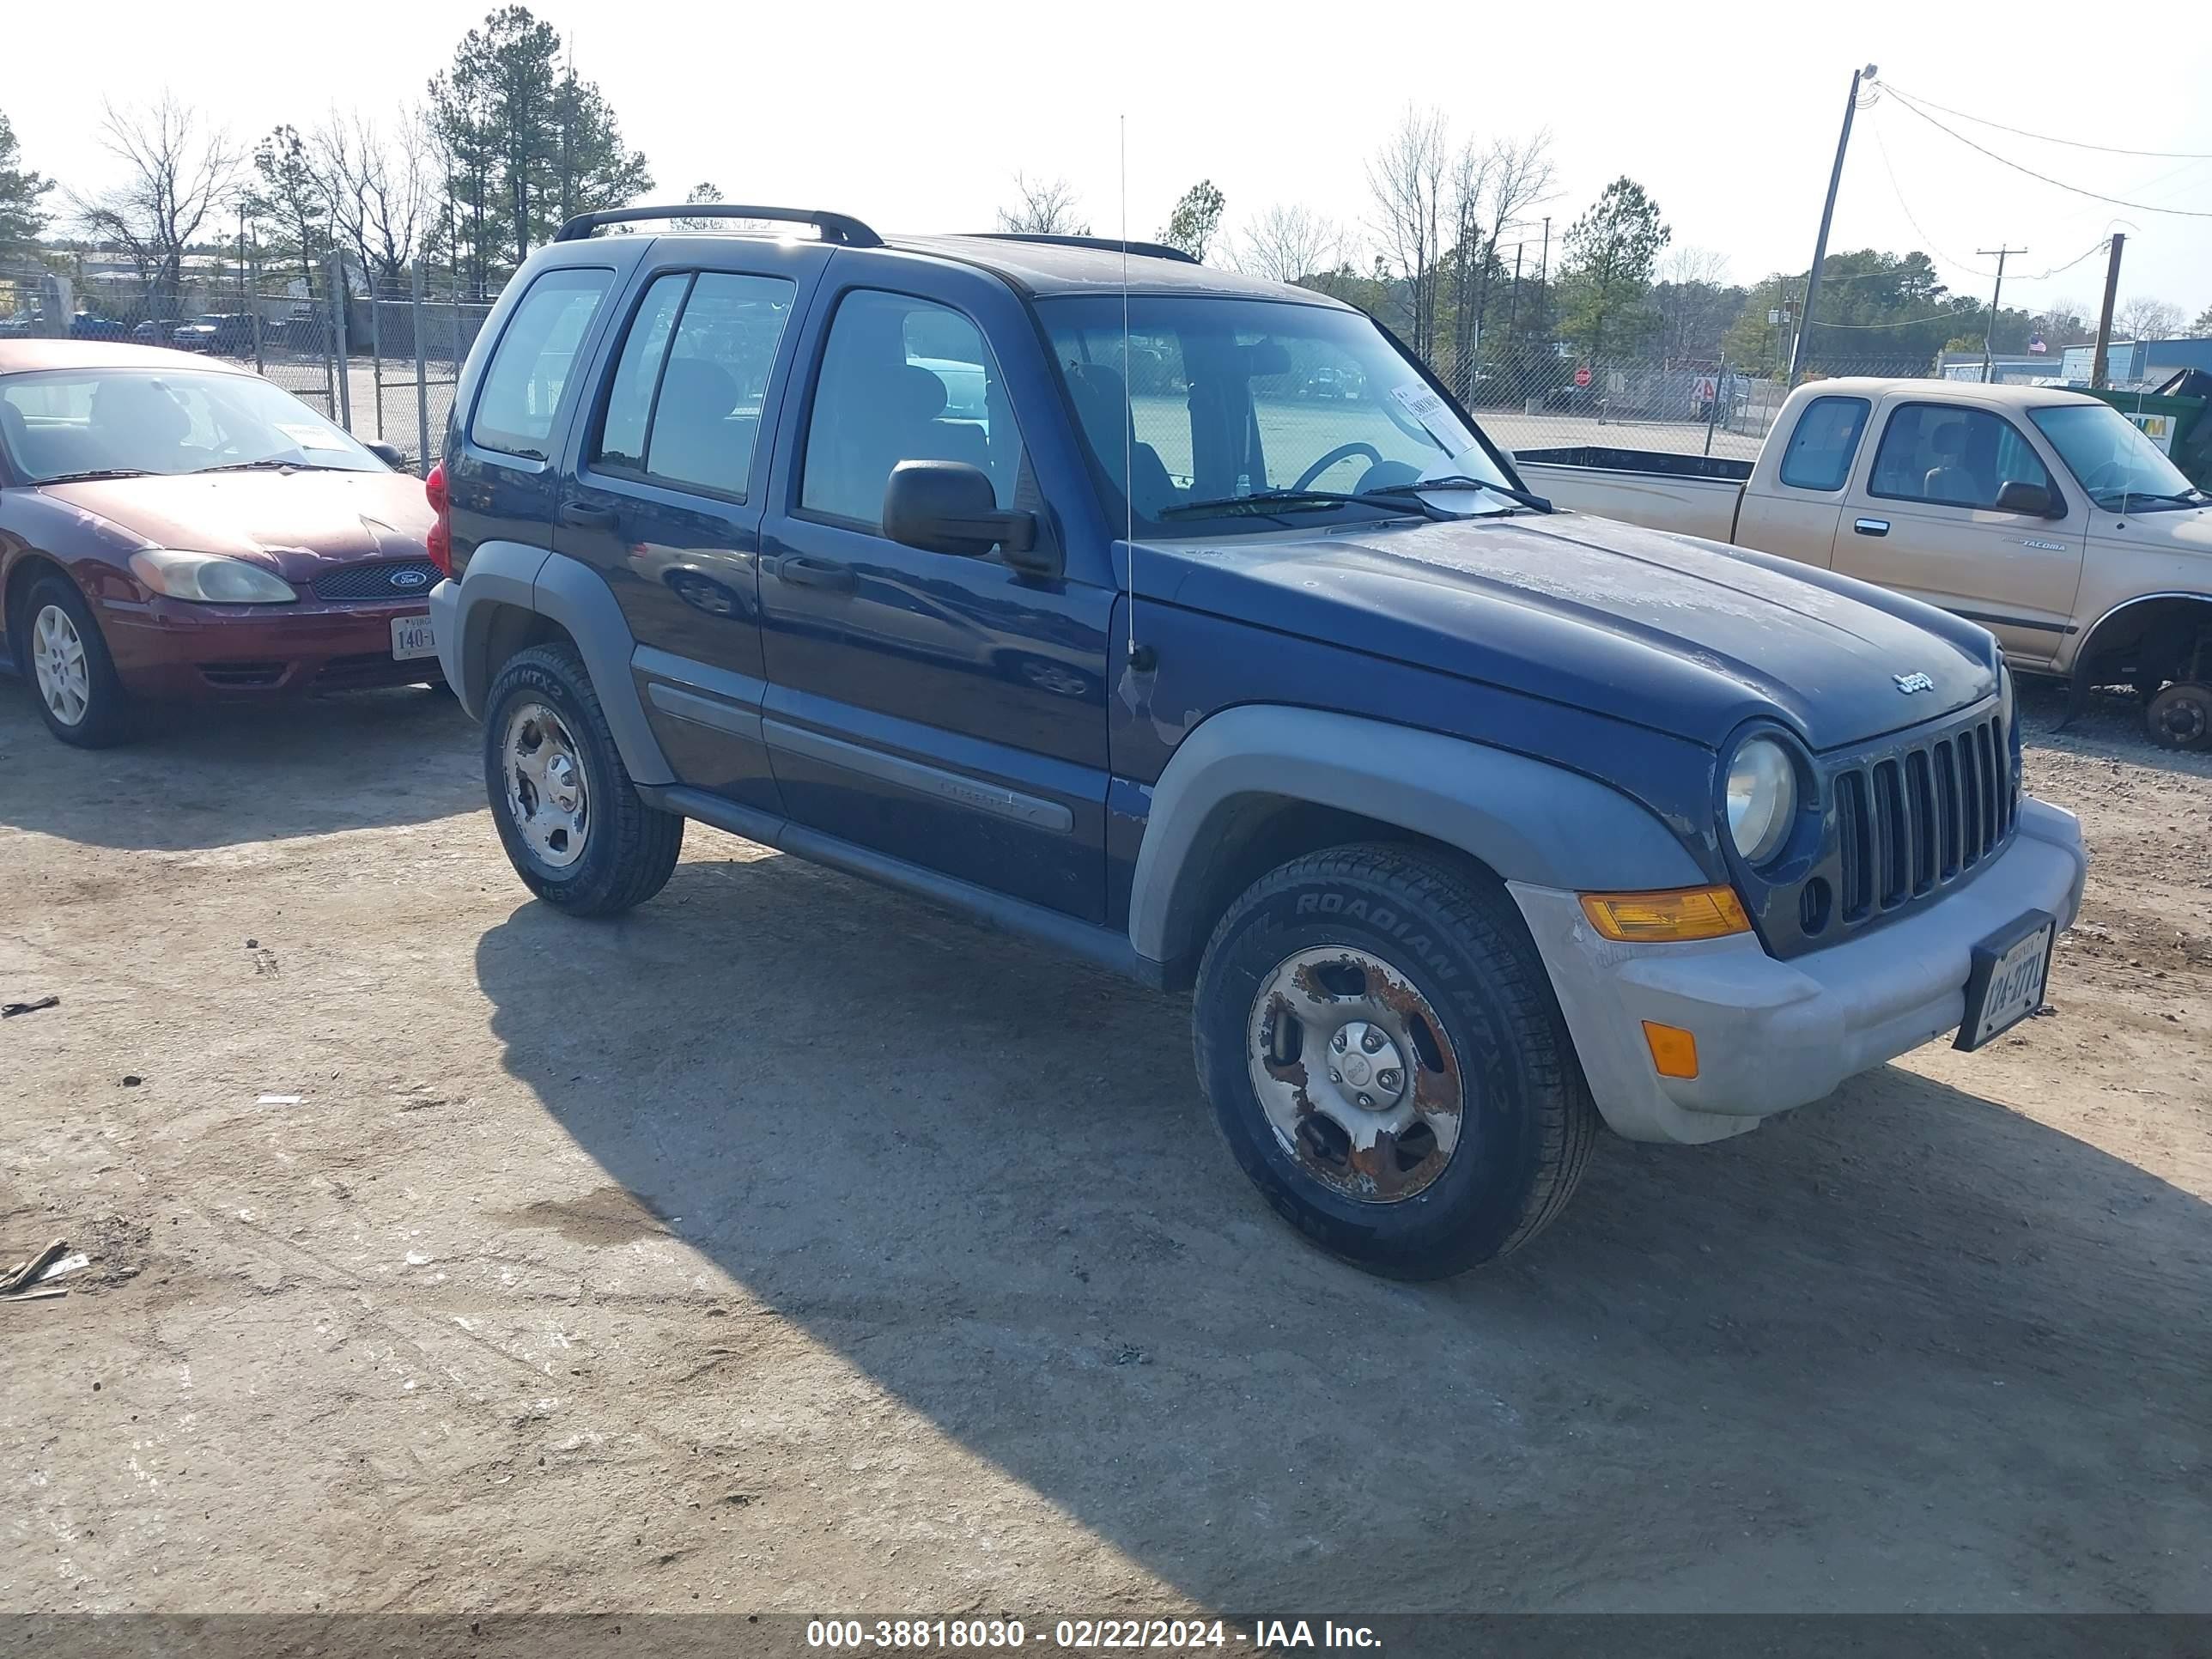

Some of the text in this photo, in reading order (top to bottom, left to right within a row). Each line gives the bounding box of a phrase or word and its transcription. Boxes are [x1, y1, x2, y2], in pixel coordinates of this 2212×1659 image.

[2021, 539, 2067, 551] TACOMA
[400, 574, 419, 584] Ford
[1892, 672, 1934, 693] Jeep
[1295, 893, 1458, 981] ROADIAN
